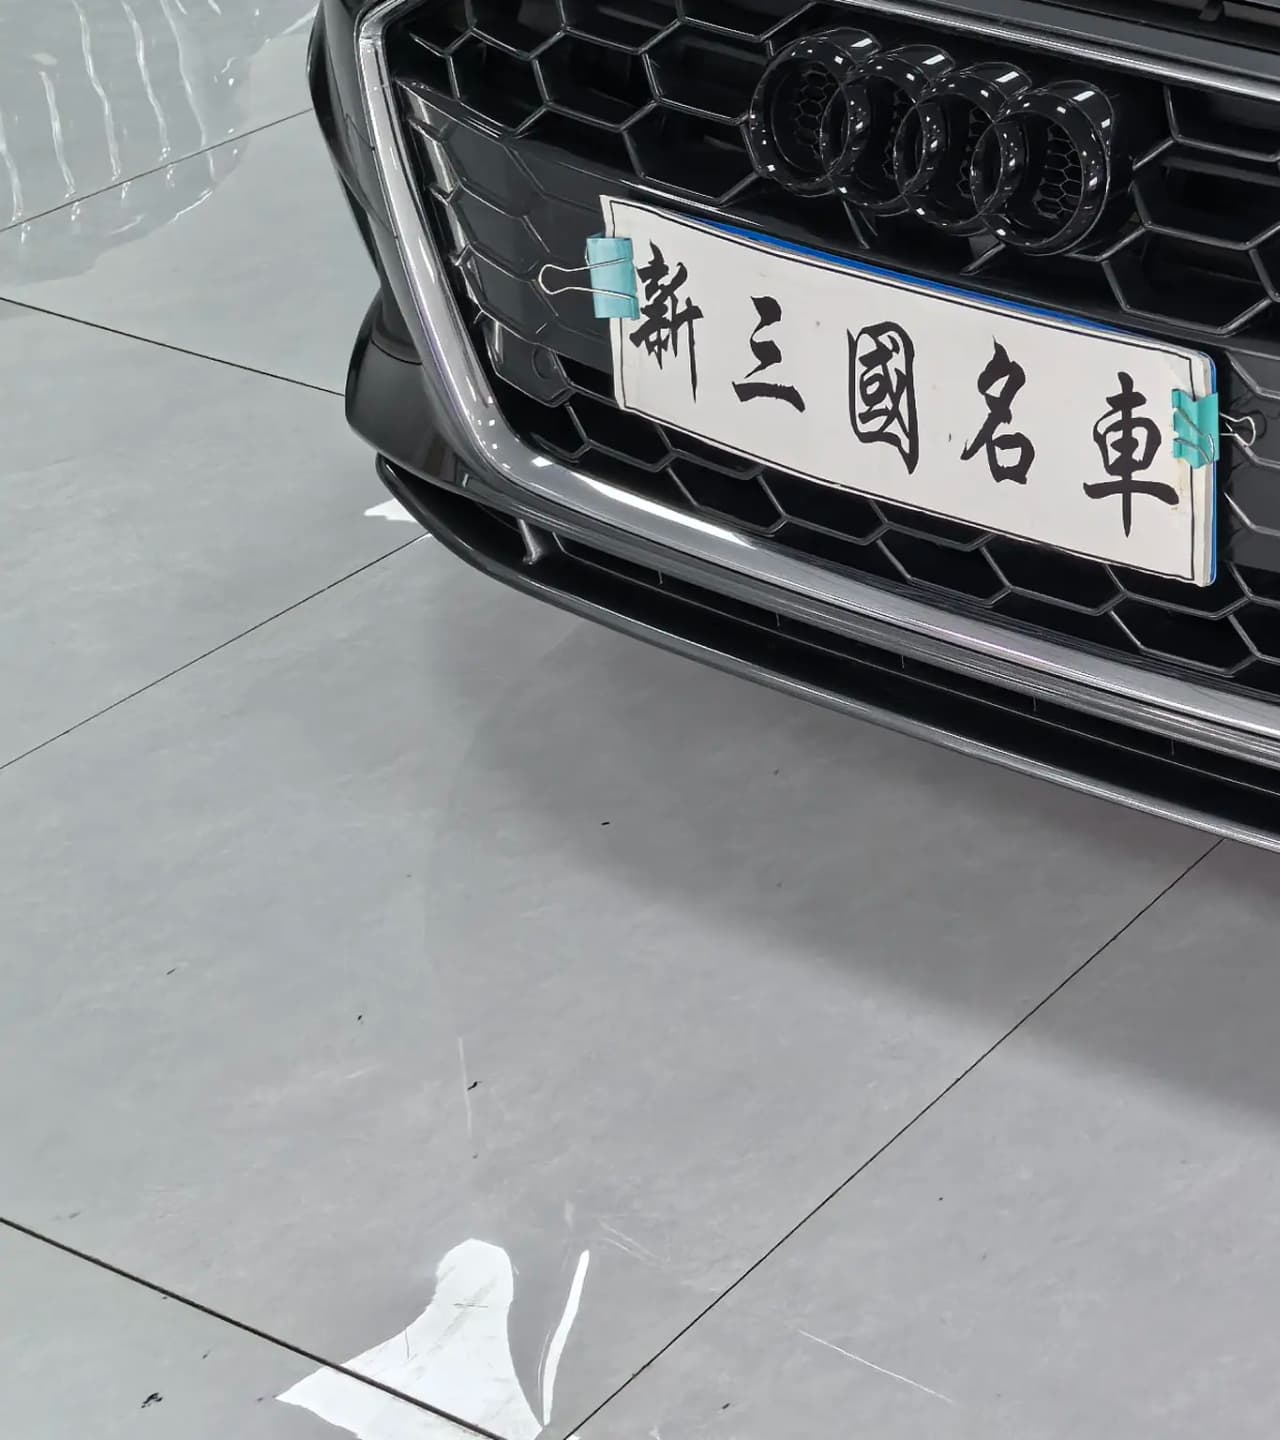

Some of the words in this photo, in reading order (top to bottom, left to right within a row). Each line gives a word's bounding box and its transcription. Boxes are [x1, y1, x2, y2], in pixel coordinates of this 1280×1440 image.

[629, 240, 1180, 537] 新三國名車
